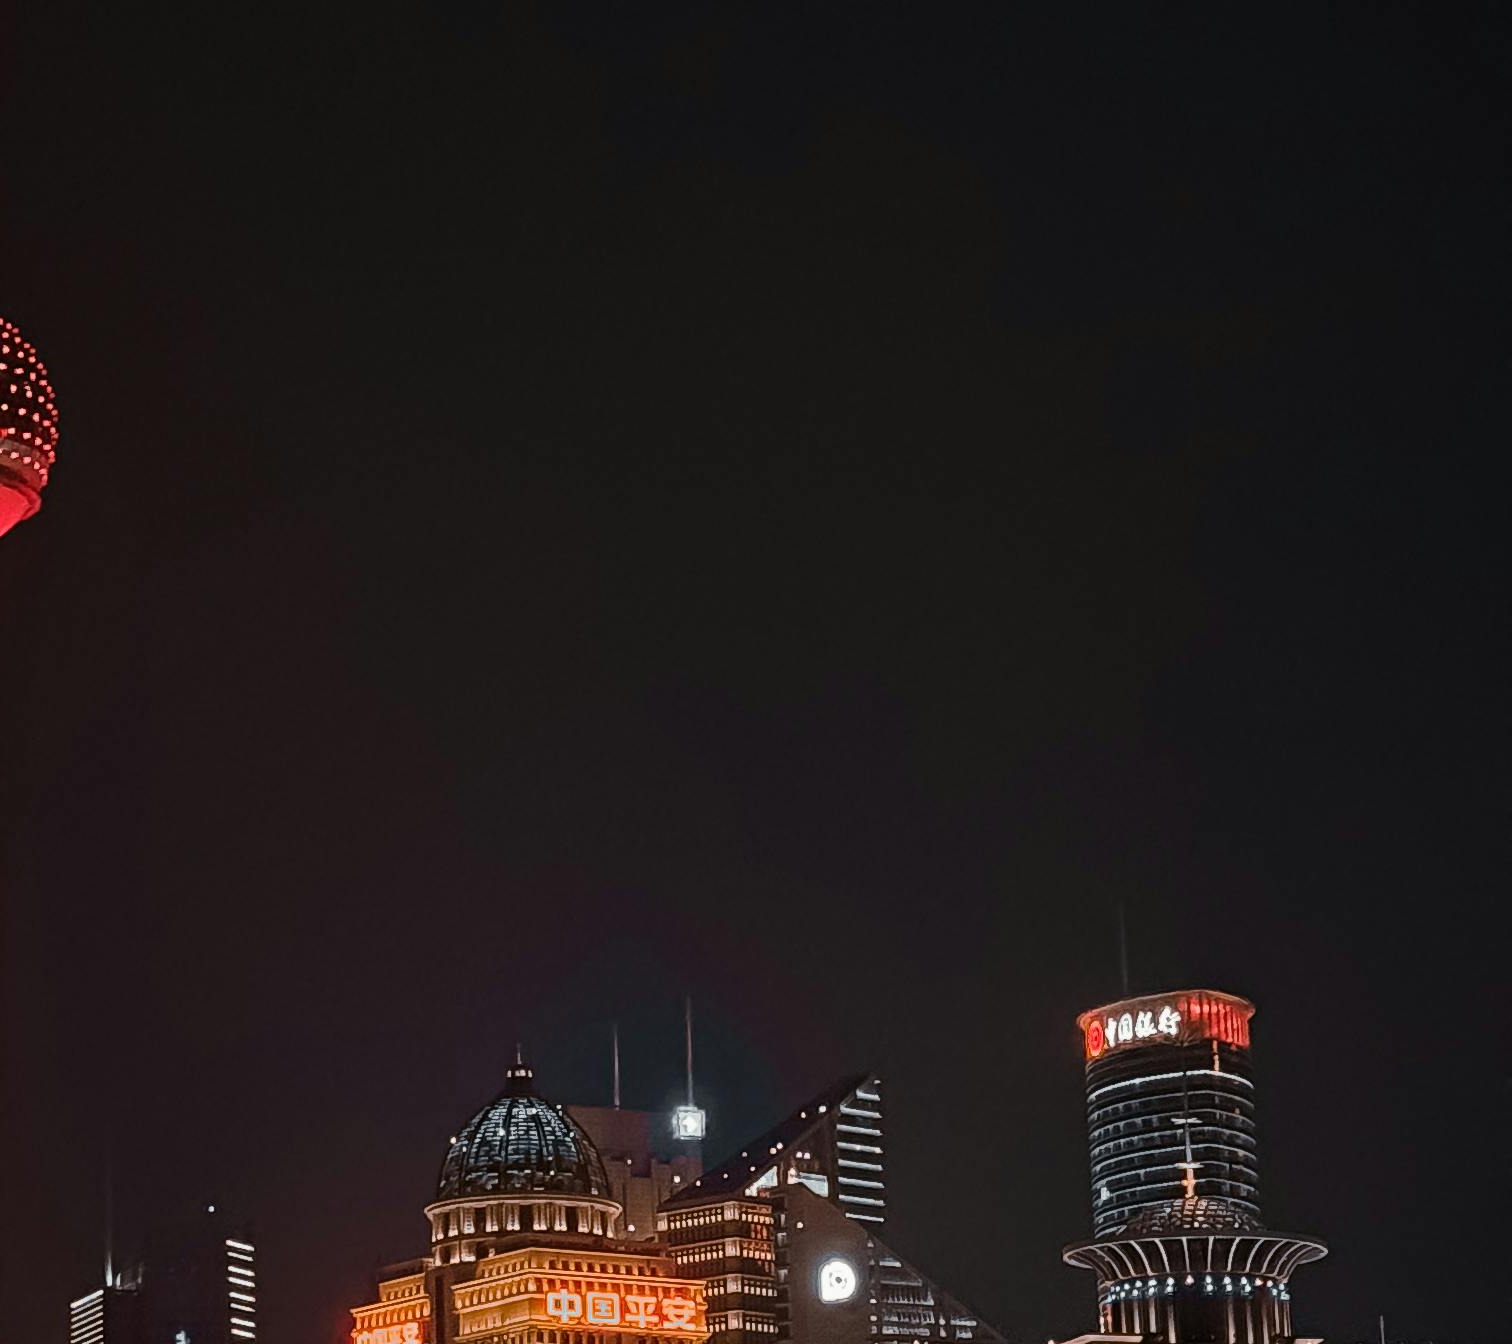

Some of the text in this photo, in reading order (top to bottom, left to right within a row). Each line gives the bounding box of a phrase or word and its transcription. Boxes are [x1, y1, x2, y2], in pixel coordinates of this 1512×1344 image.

[1104, 1005, 1182, 1048] 中国银行
[547, 1288, 697, 1331] 中国平安
